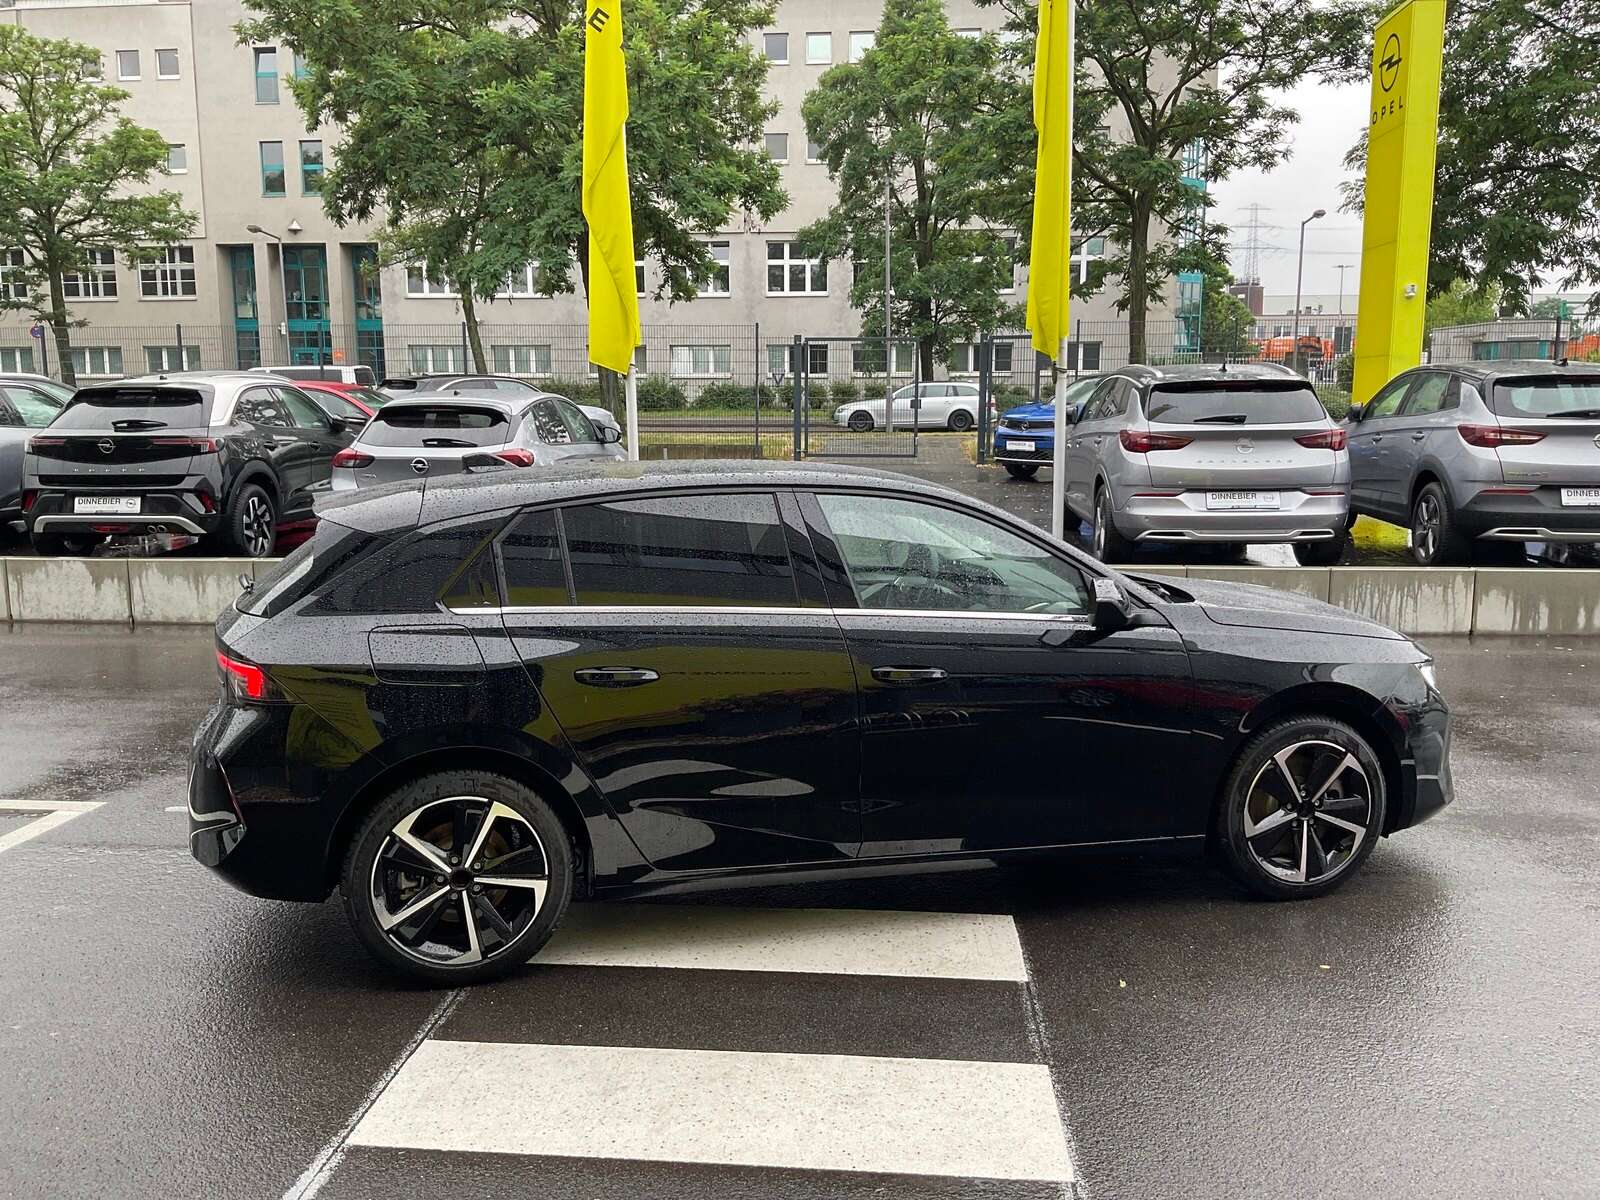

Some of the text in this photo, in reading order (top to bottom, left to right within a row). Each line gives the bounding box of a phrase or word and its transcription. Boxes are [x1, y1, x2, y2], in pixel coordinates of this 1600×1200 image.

[588, 7, 610, 33] E
[1372, 95, 1403, 125] OPEL
[77, 497, 121, 505] DINNEBIER
[1211, 492, 1257, 500] DINNEBIER
